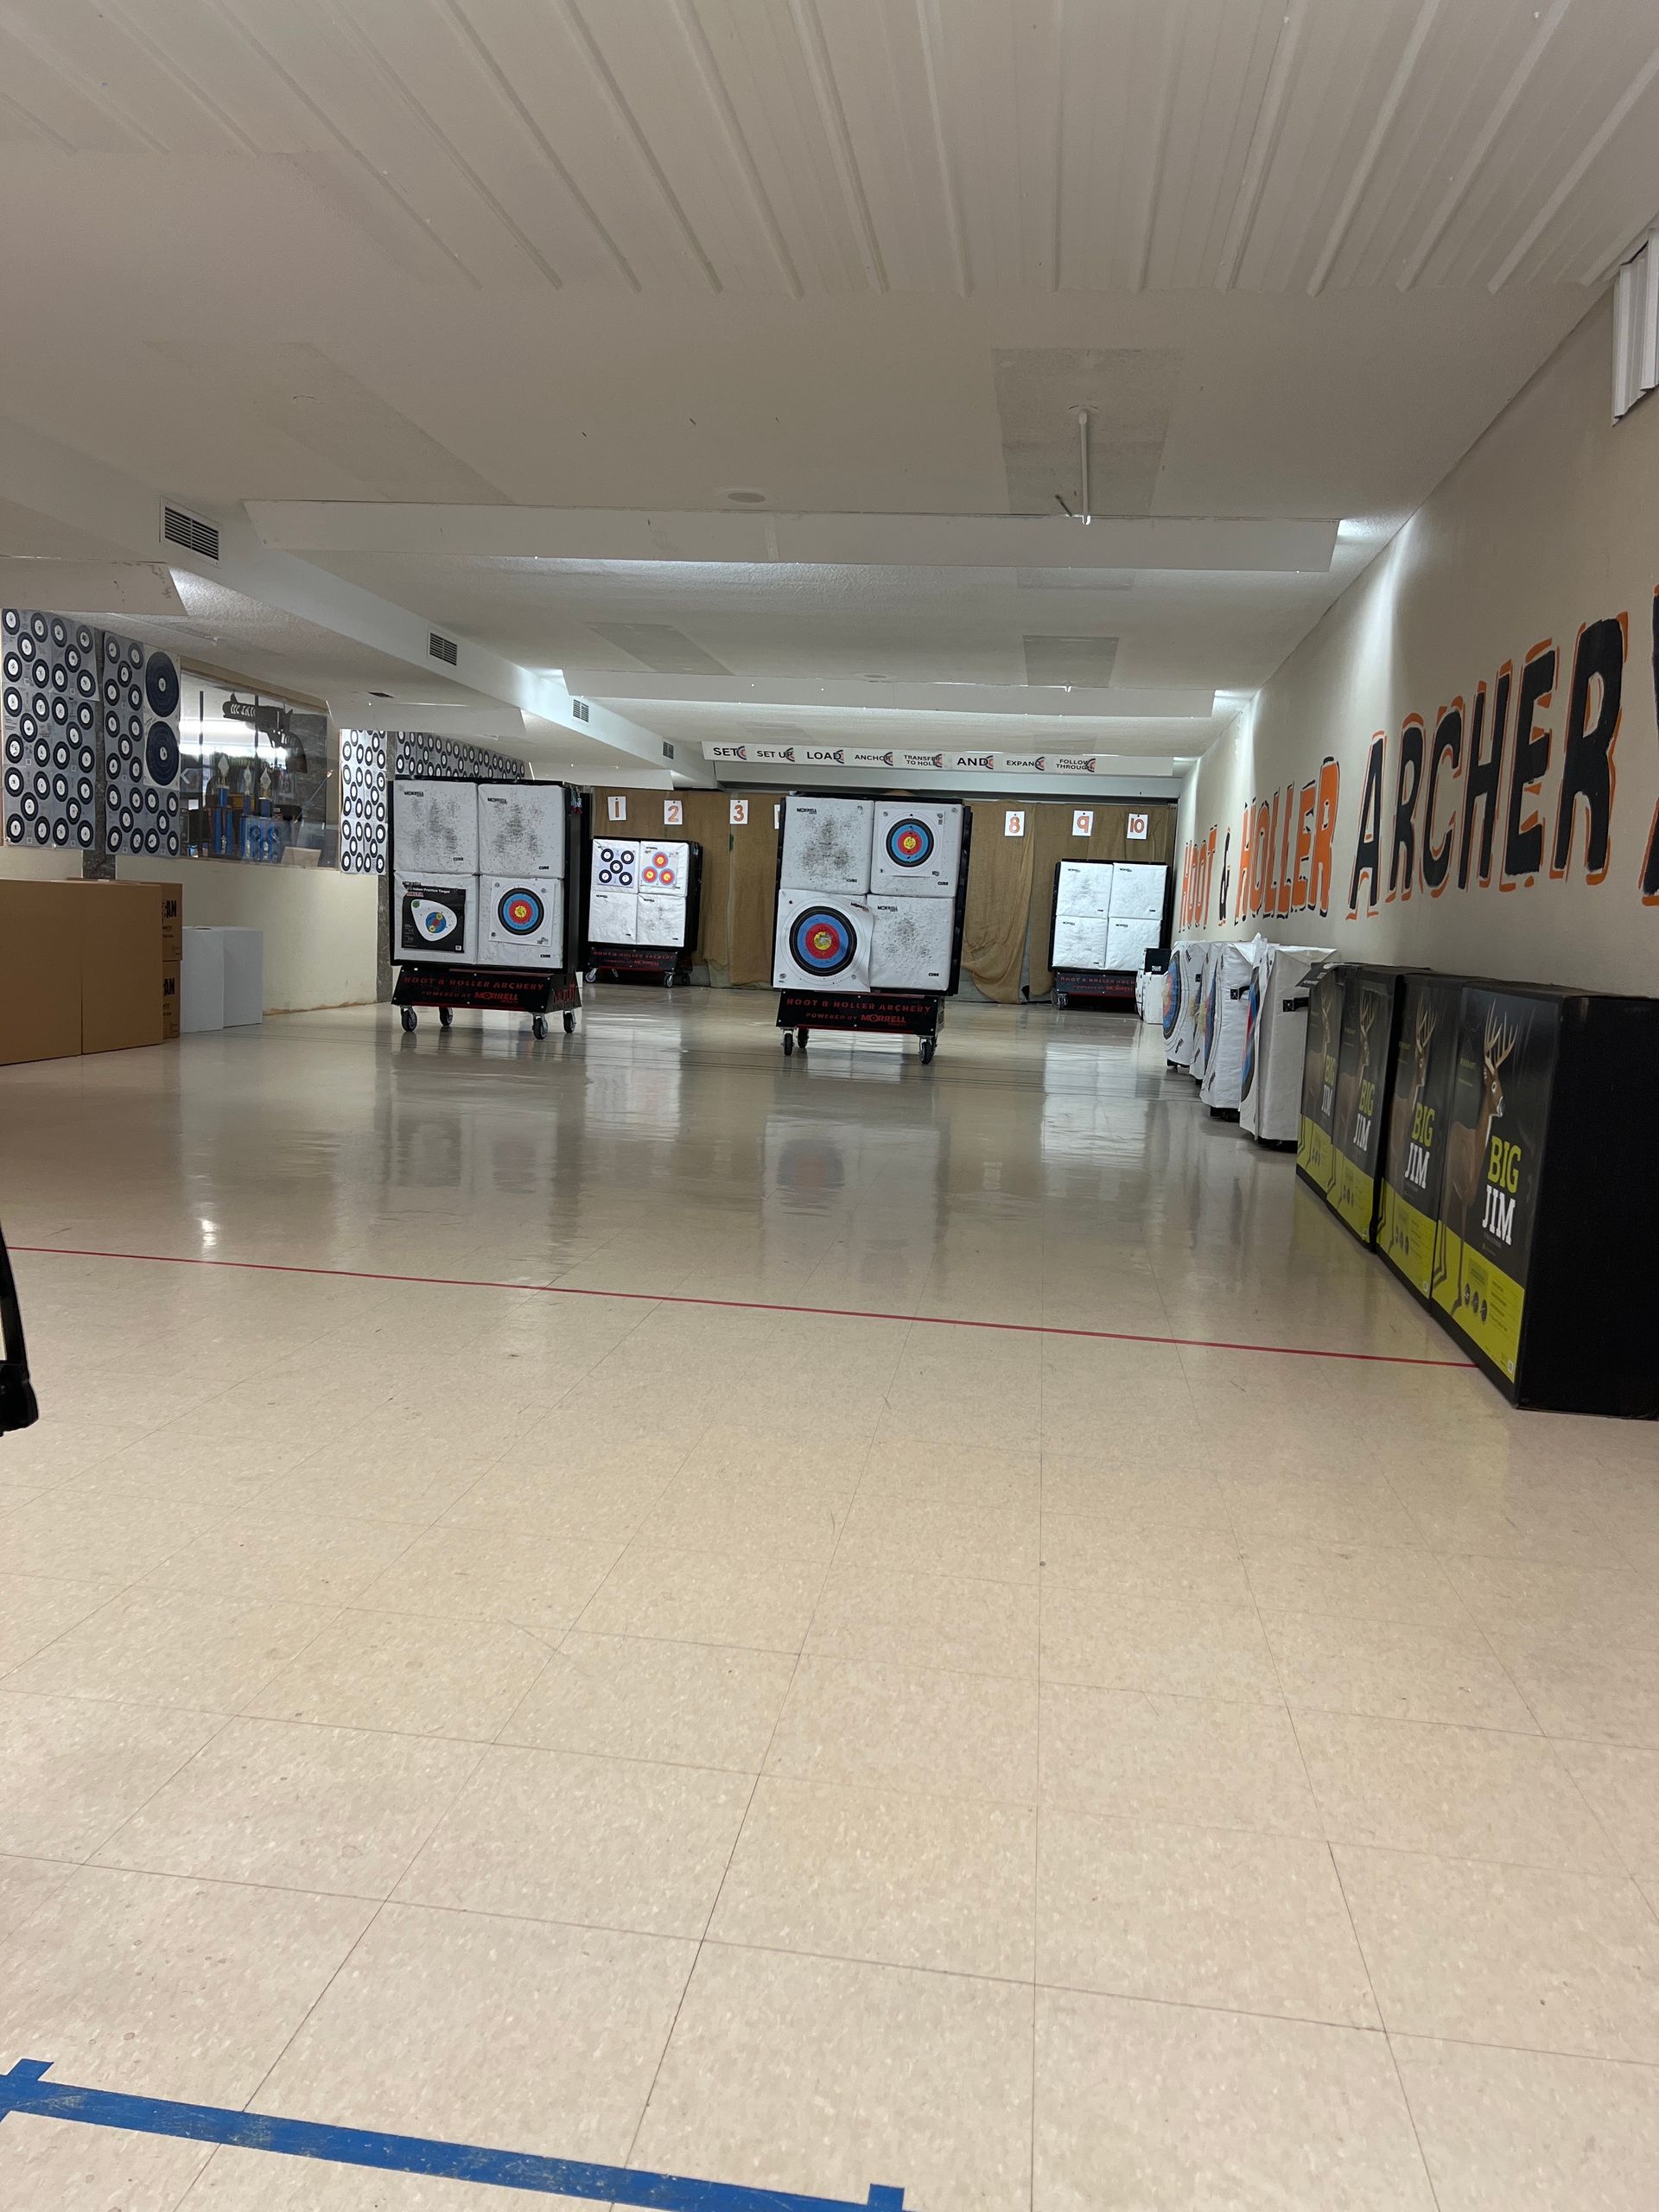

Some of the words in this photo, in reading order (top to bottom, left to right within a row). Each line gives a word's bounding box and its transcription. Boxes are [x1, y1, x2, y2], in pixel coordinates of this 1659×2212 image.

[713, 747, 738, 756] SET
[807, 751, 842, 760] LOAD
[957, 757, 988, 766] AND
[668, 805, 679, 823] 2
[734, 804, 745, 822] 3
[1008, 817, 1020, 834] 8
[1077, 816, 1090, 834] 9
[1129, 817, 1145, 834] 10
[1179, 823, 1217, 933] HOOT
[1217, 826, 1230, 926] &
[1234, 756, 1340, 927] HOLLER
[493, 981, 545, 991] ARCHERY
[787, 998, 817, 1007] HOOT
[832, 1001, 875, 1010] HOLLER
[878, 1002, 931, 1014] ARCHERY
[860, 1014, 906, 1023] MORRELL
[1325, 1055, 1338, 1087] BIG
[1320, 1084, 1333, 1117] JIM
[1358, 1079, 1375, 1117] BIG
[1353, 1113, 1371, 1152] JIM
[1411, 1102, 1435, 1147] BIG
[1404, 1141, 1431, 1190] JIM
[1487, 1135, 1522, 1194] BIG
[1482, 1184, 1516, 1246] JIM
